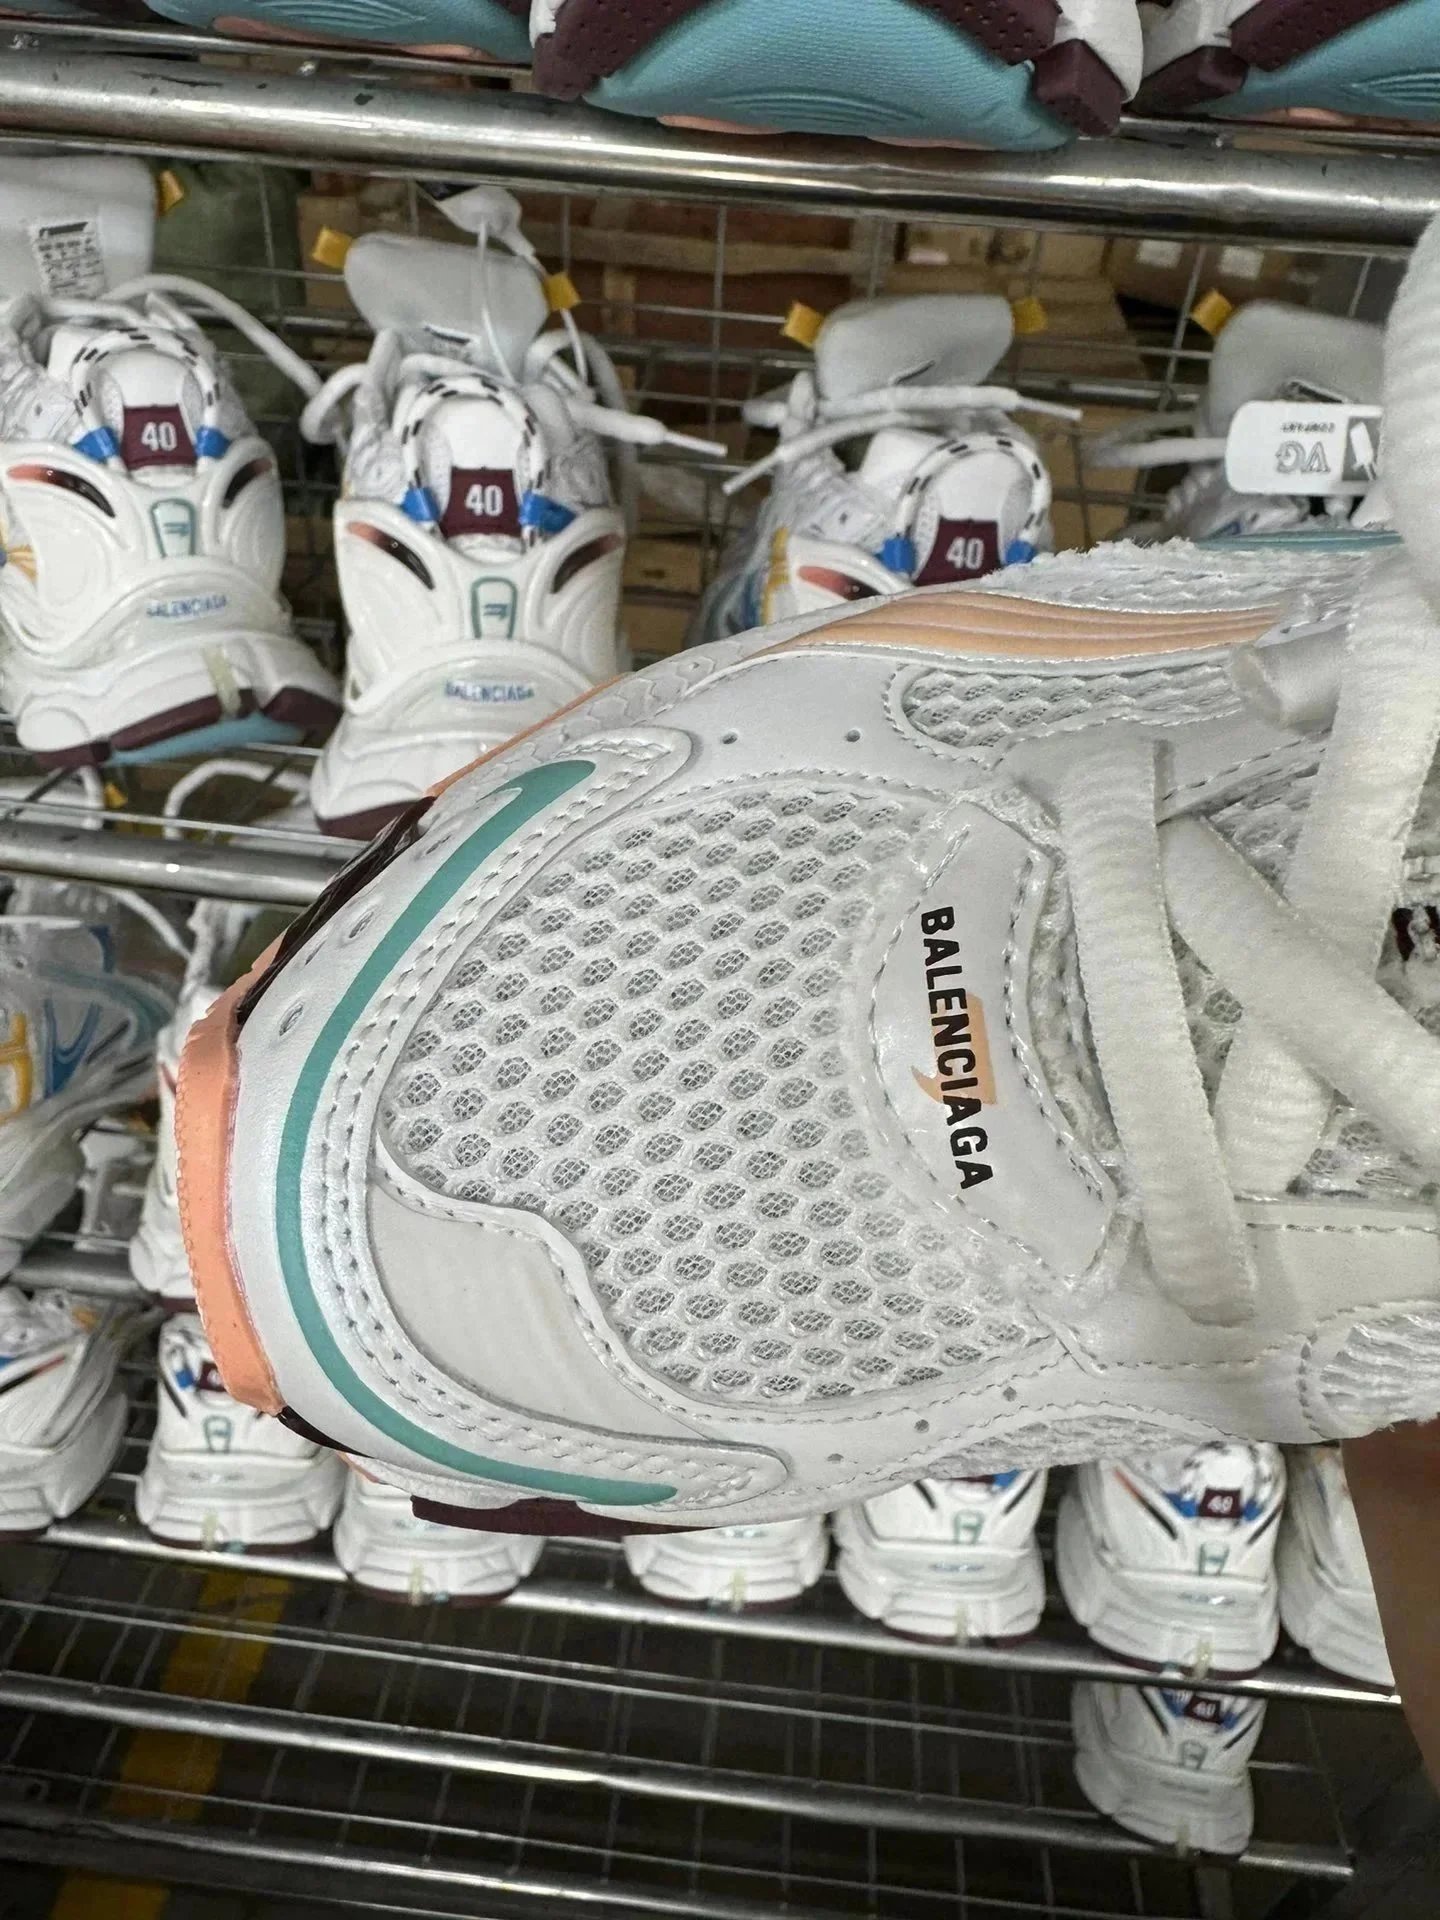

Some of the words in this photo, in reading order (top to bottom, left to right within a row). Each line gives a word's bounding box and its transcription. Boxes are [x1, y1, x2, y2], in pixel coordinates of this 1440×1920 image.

[141, 421, 178, 452] 40
[1275, 441, 1331, 474] VG
[465, 484, 504, 516] 40
[946, 536, 985, 570] 40
[921, 906, 994, 1190] BALENCIAGA
